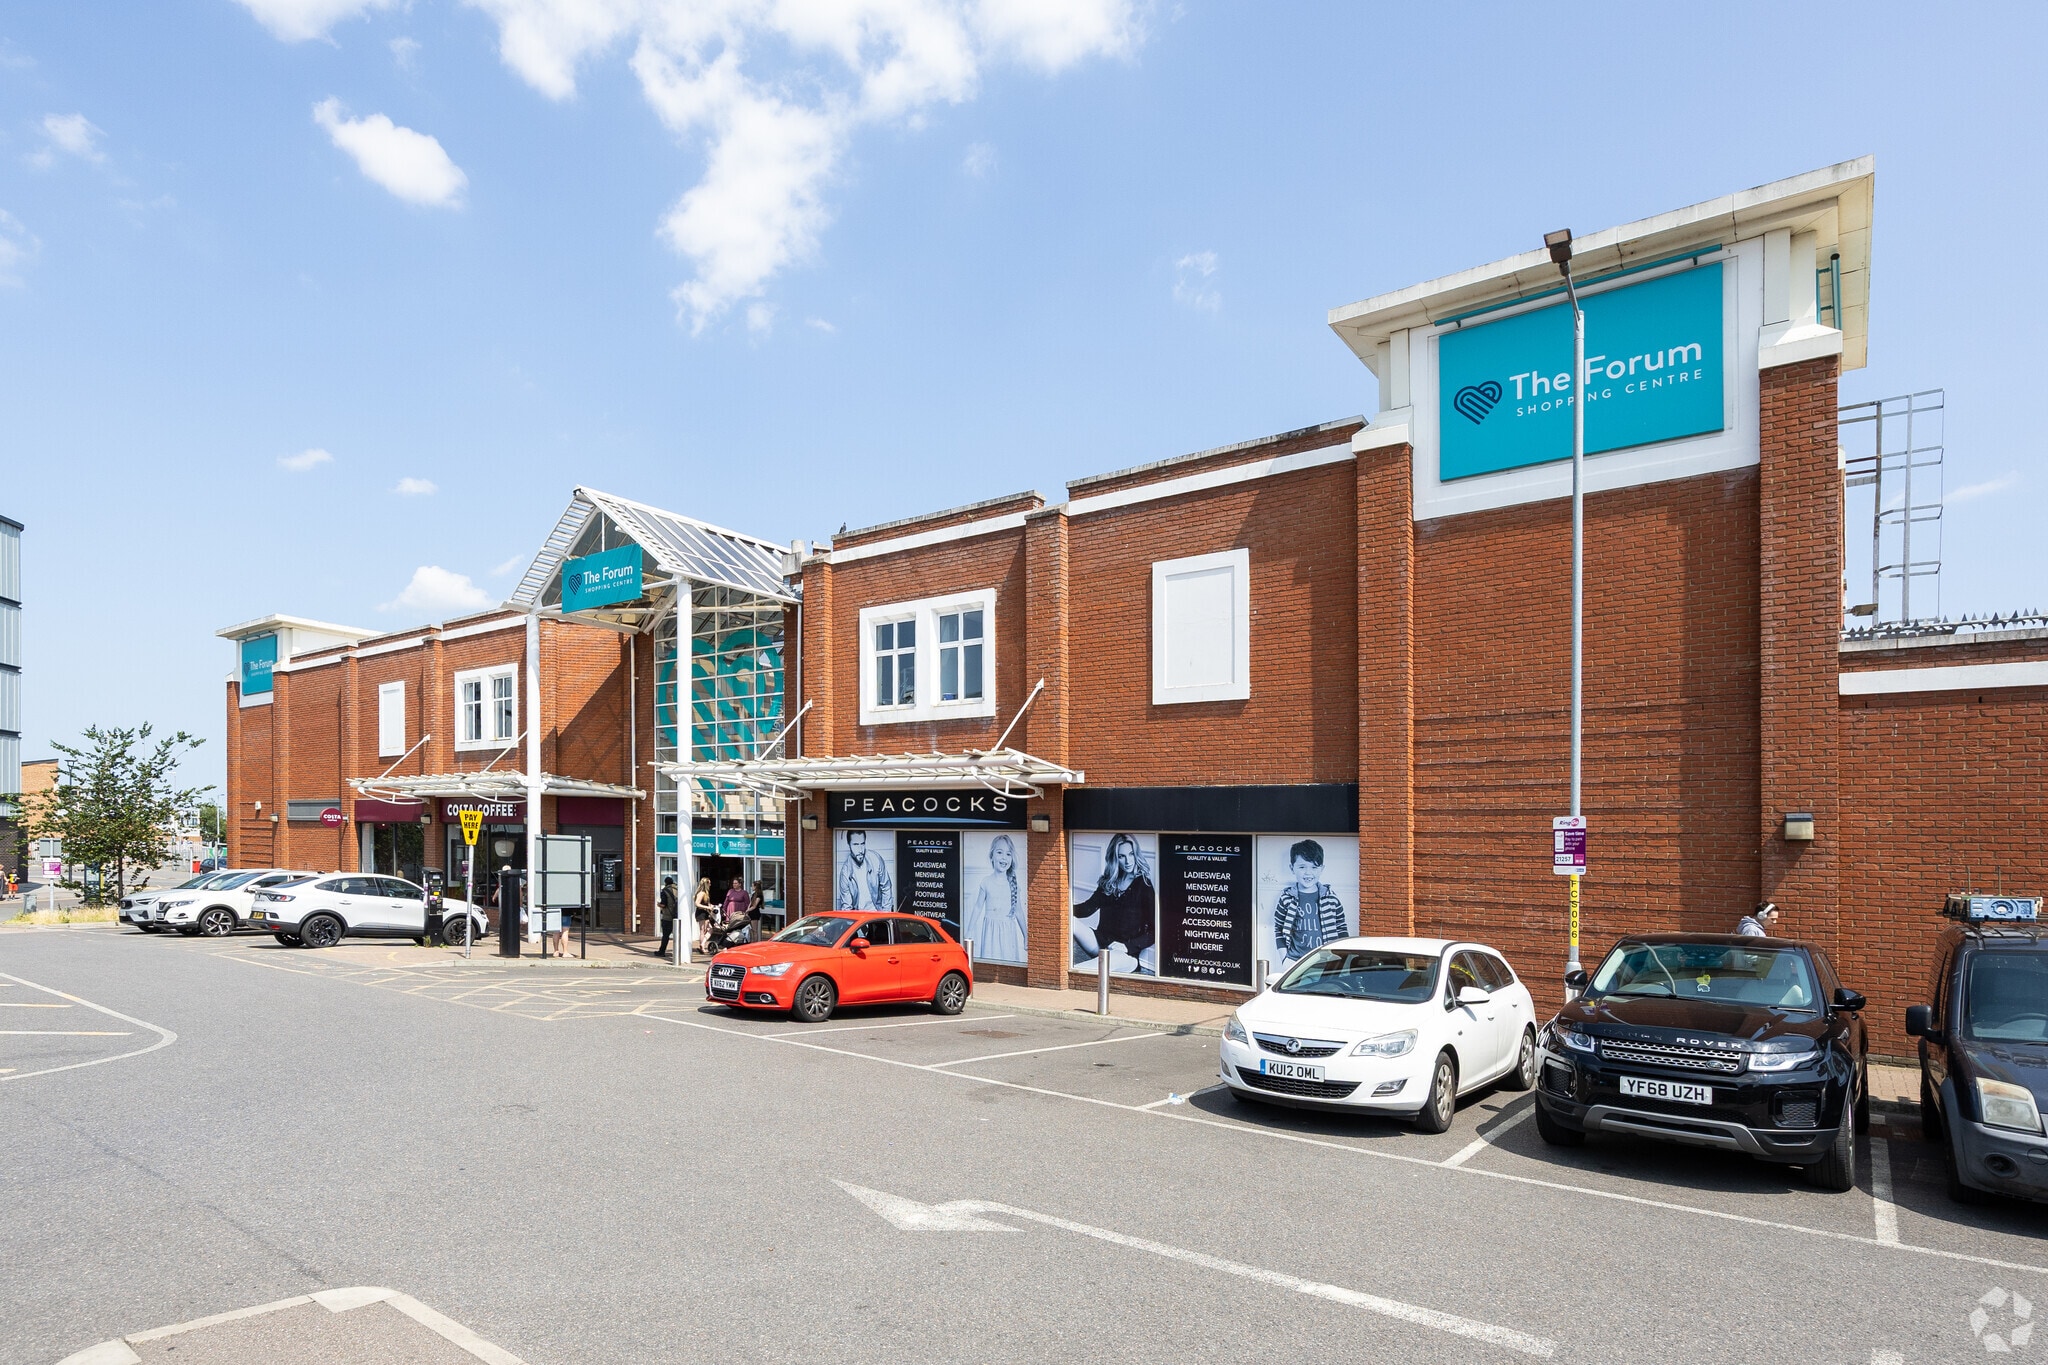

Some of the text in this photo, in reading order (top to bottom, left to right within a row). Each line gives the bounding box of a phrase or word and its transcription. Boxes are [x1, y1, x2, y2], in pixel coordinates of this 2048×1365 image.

[1508, 342, 1702, 400] The Forum
[1516, 369, 1703, 417] SHOPPNG CENTRE
[583, 565, 633, 585] The Forum
[584, 578, 633, 594] SHOPPING CENTRE
[843, 796, 1008, 813] PEACOCKS
[464, 813, 478, 821] PAY
[463, 822, 479, 830] HERE
[1174, 844, 1241, 852] PEACOCKS
[913, 861, 947, 869] LADIESWEAR
[914, 871, 945, 879] MENSWEAR
[1183, 871, 1231, 880] LADIESWEAR
[916, 881, 944, 889] KIDSWEAR
[1185, 883, 1229, 892] MENSWEAR
[914, 891, 945, 899] FOOTWEAR
[1187, 894, 1227, 904] KIDSWEAR
[912, 900, 948, 909] ACCESSORIES
[914, 911, 946, 919] NIGHTWEAR
[1185, 906, 1229, 916] FOOTWEAR
[1181, 918, 1233, 929] ACCESSORIES
[1184, 930, 1230, 940] NIGHTWEAR
[1190, 942, 1224, 952] LINGERIE
[1173, 957, 1241, 969] WWW.PEACOCKS.CO.UK
[1676, 1037, 1742, 1049] ROVER
[1269, 1062, 1320, 1080] KU12 OML
[1626, 1079, 1705, 1101] YF68 UZH
